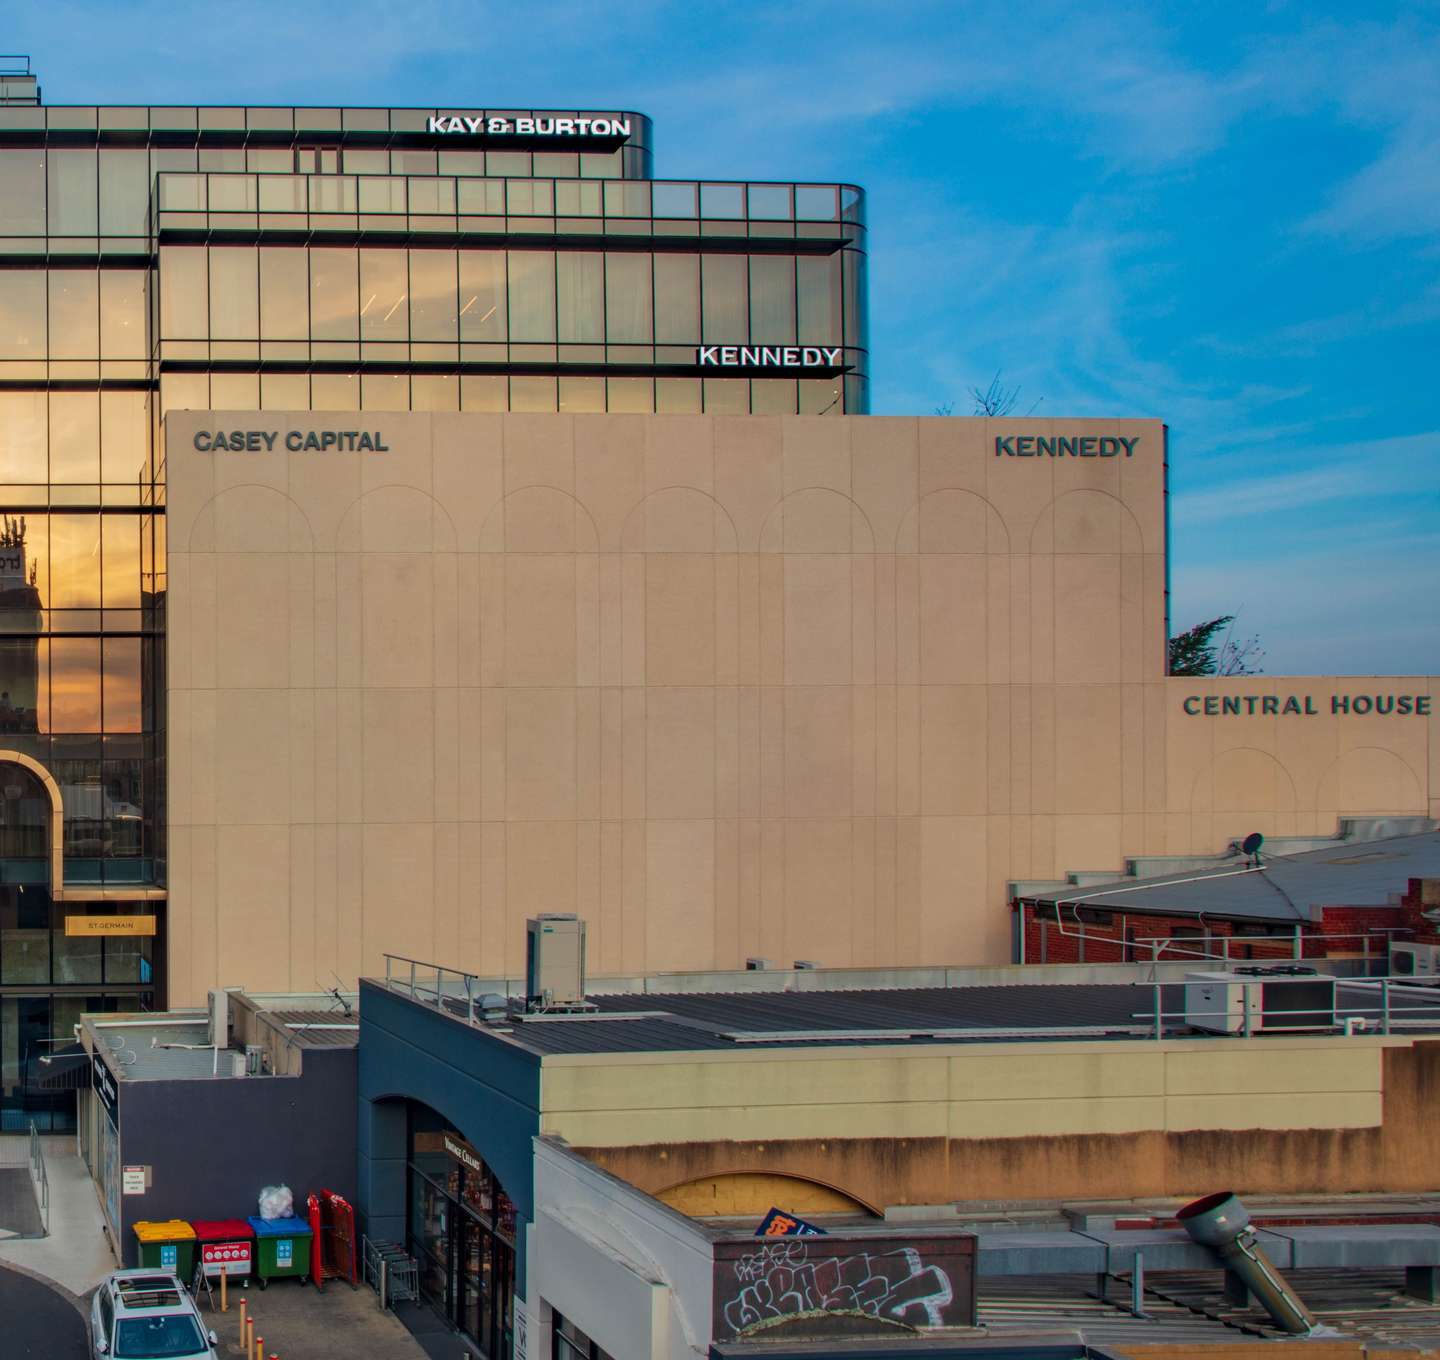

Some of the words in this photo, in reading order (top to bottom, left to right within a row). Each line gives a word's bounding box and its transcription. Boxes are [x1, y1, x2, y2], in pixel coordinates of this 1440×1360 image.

[428, 116, 483, 134] KAY
[488, 117, 510, 135] &
[516, 117, 631, 136] BURTON
[698, 345, 842, 367] KENNEDY
[193, 430, 278, 452] CASEY
[286, 430, 389, 452] CAPITAL
[994, 436, 1140, 458] KENNEDY
[1183, 695, 1318, 716] CENTRAL
[1331, 695, 1432, 715] HOUSE
